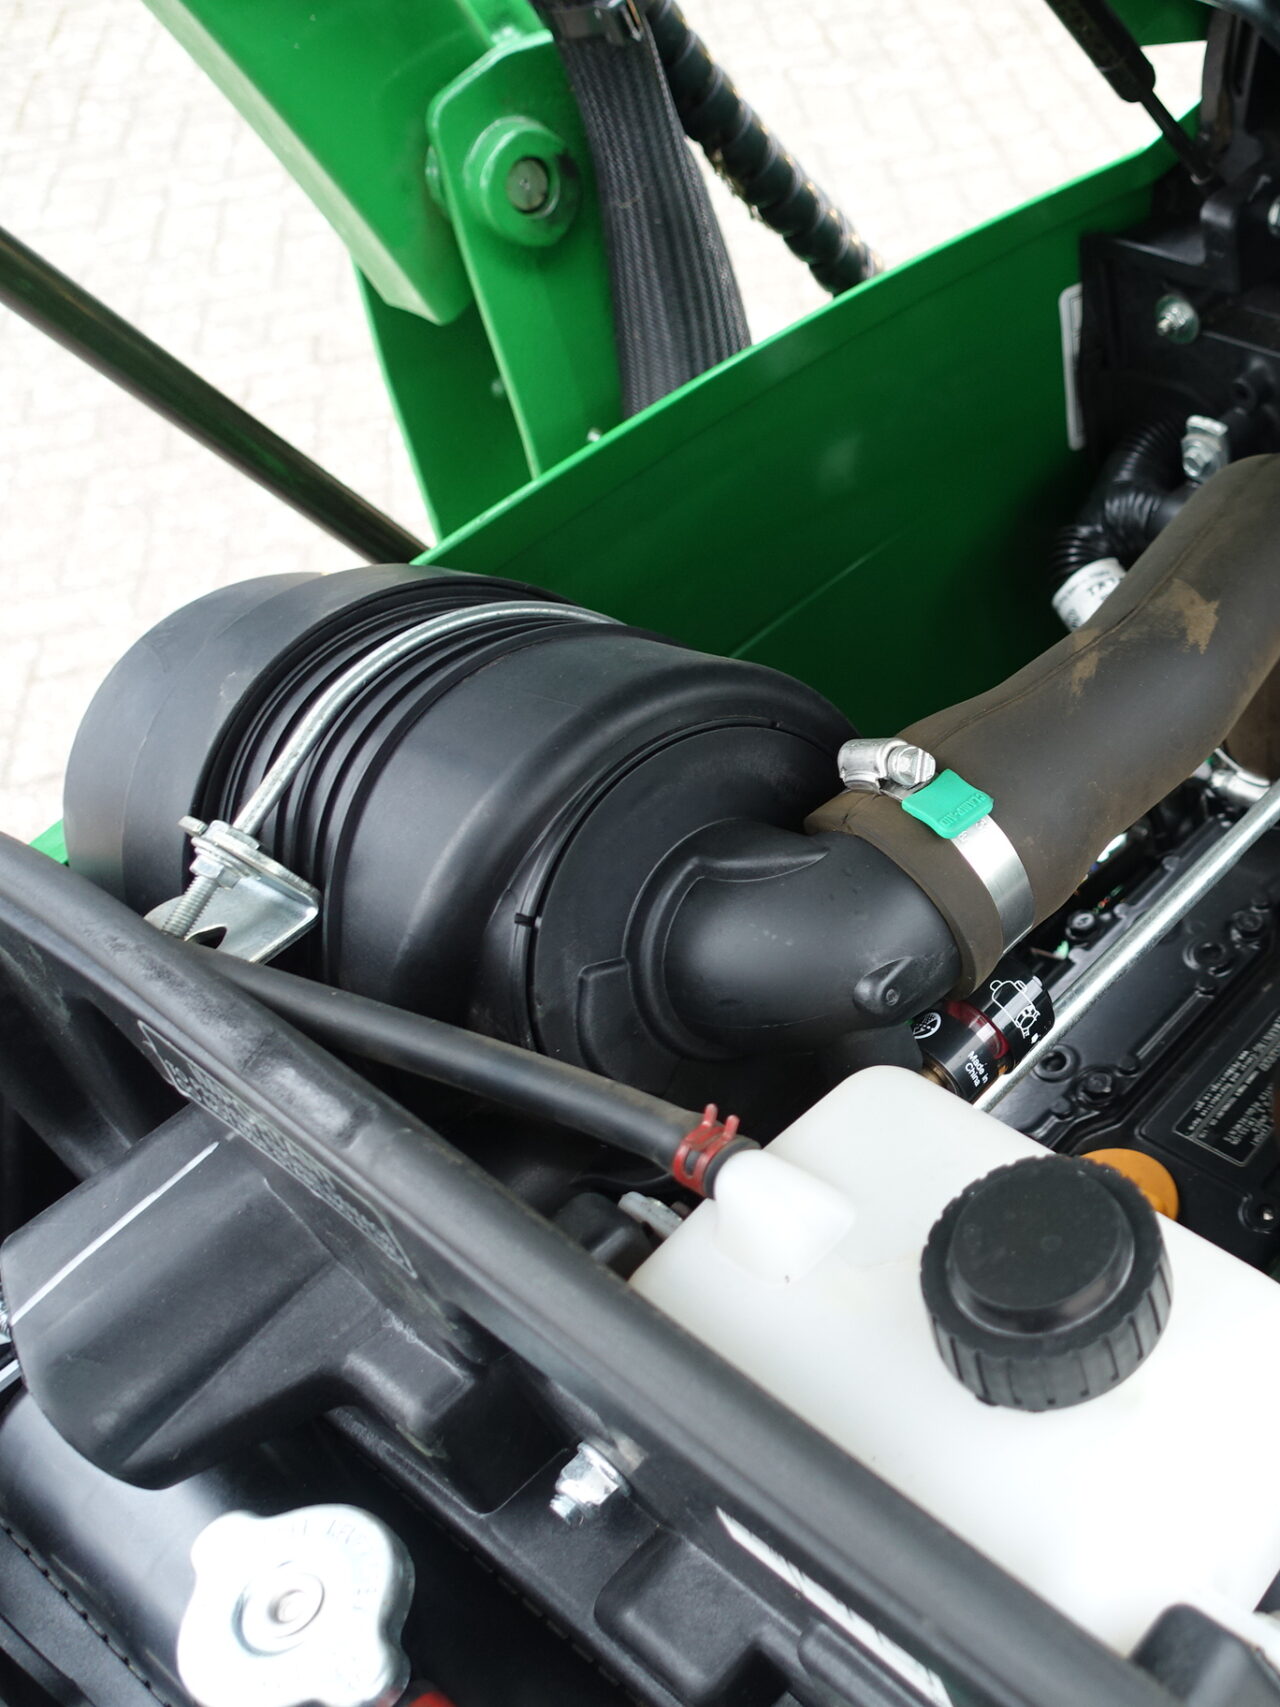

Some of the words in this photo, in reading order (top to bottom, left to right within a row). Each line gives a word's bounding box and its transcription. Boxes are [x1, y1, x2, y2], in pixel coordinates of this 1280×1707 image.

[965, 1062, 981, 1086] China
[967, 1050, 985, 1075] Made
[981, 1072, 989, 1083] in
